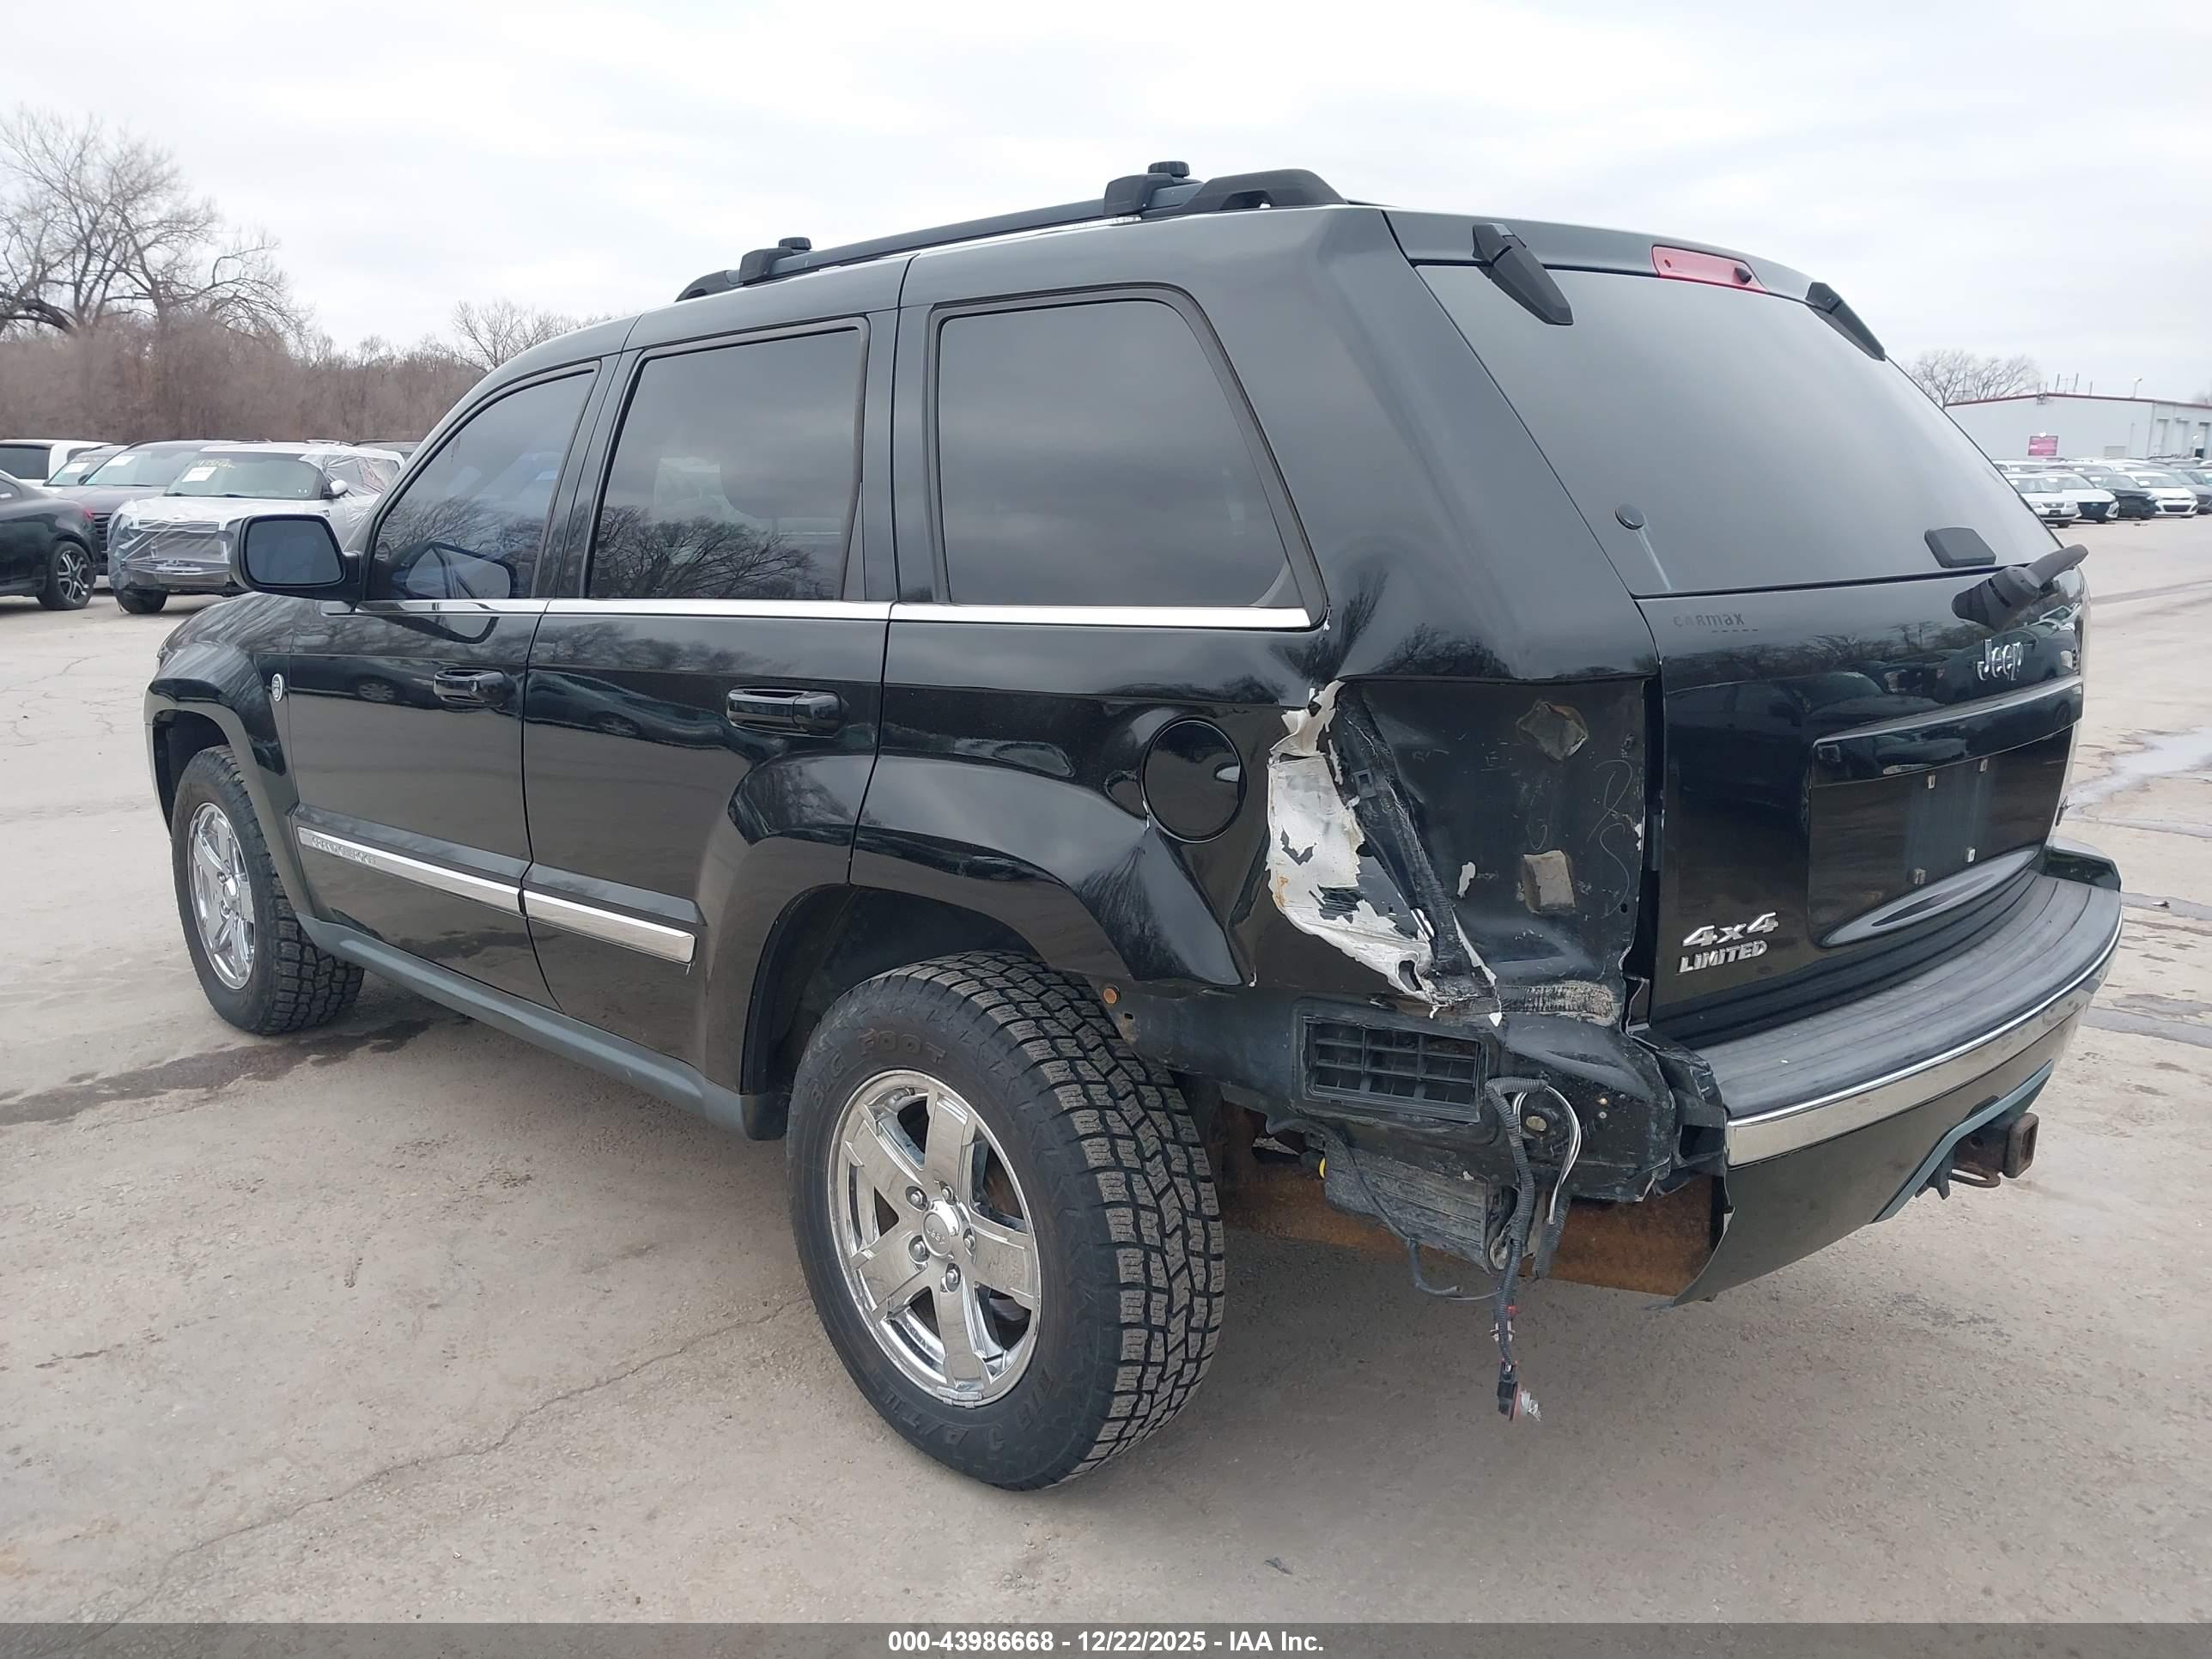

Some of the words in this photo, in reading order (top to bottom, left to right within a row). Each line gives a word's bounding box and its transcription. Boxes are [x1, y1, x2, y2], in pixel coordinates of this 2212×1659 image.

[1977, 639, 2024, 681] Jeep
[1682, 912, 1779, 946] 4x4
[1679, 940, 1768, 973] LIMITED
[859, 1028, 947, 1066] FOOT
